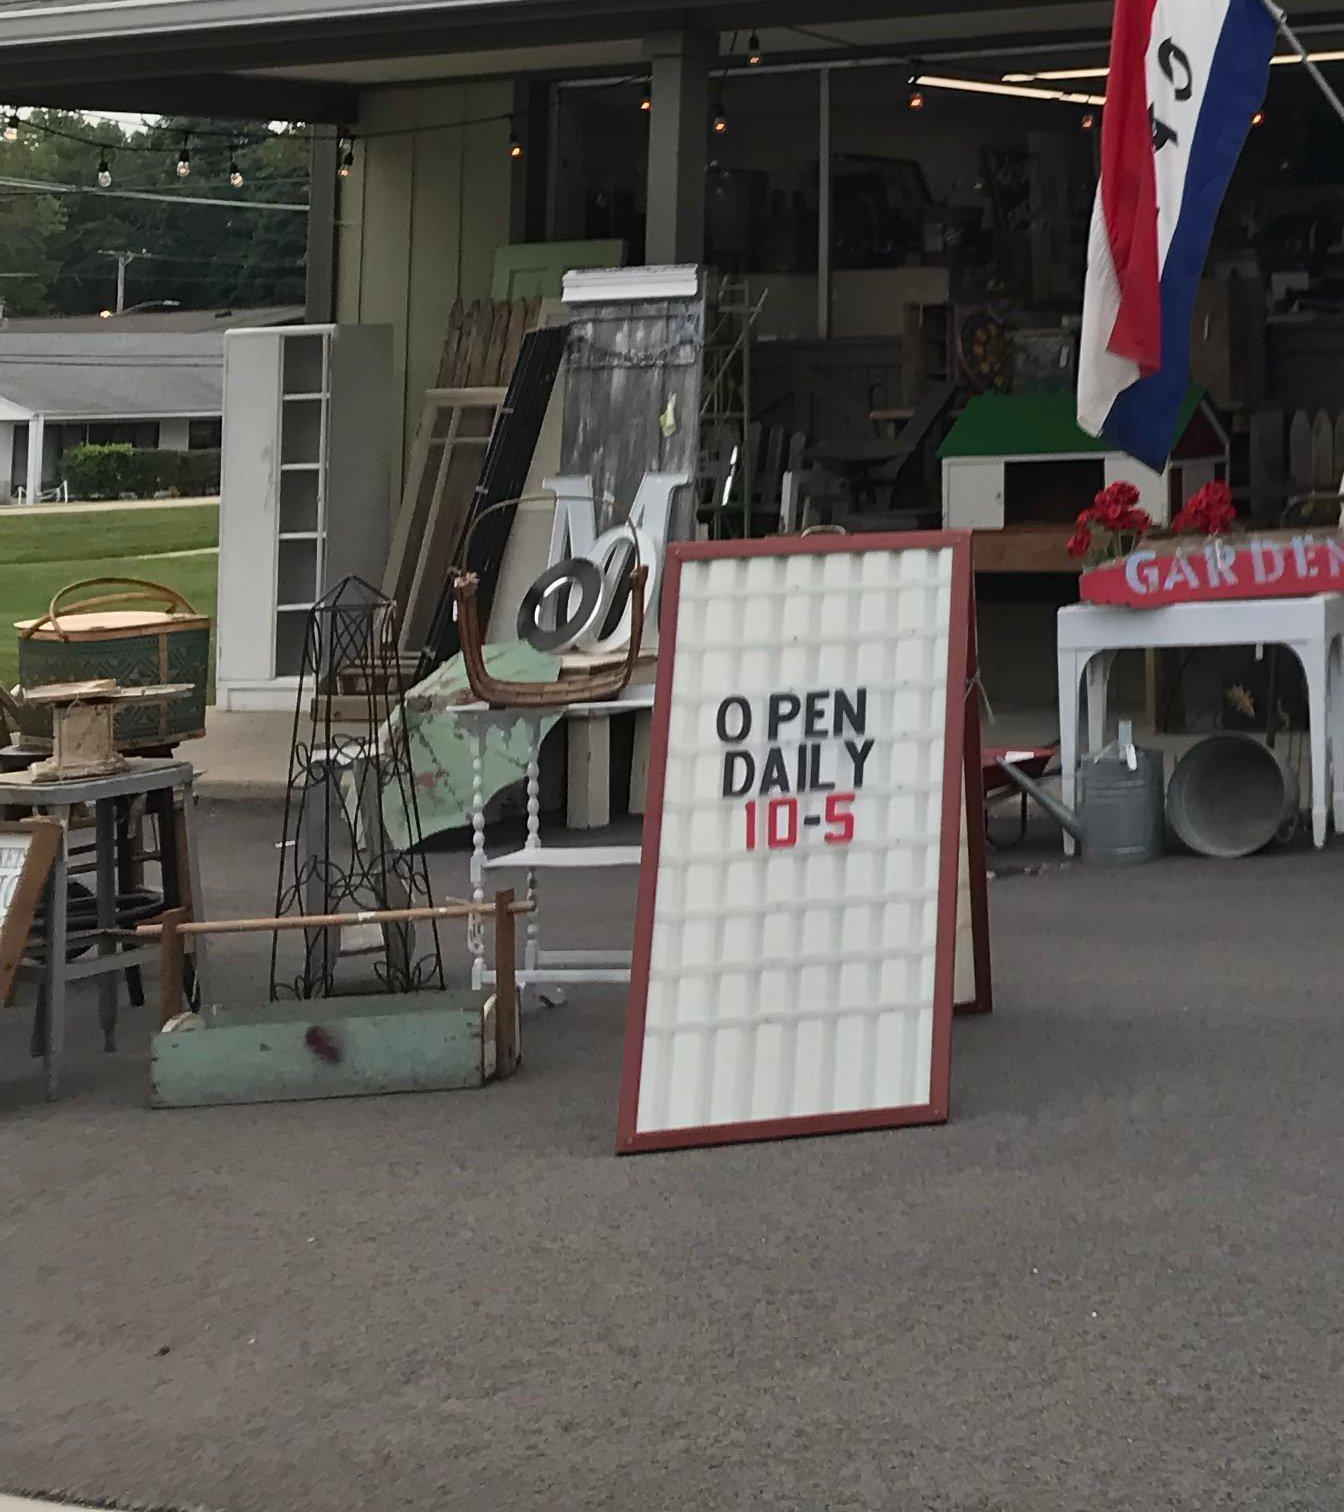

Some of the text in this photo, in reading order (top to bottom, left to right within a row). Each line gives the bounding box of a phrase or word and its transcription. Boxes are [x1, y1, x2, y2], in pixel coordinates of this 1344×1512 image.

[716, 687, 868, 743] OPEN
[722, 738, 876, 799] DAILY
[744, 791, 857, 852] 10-5
